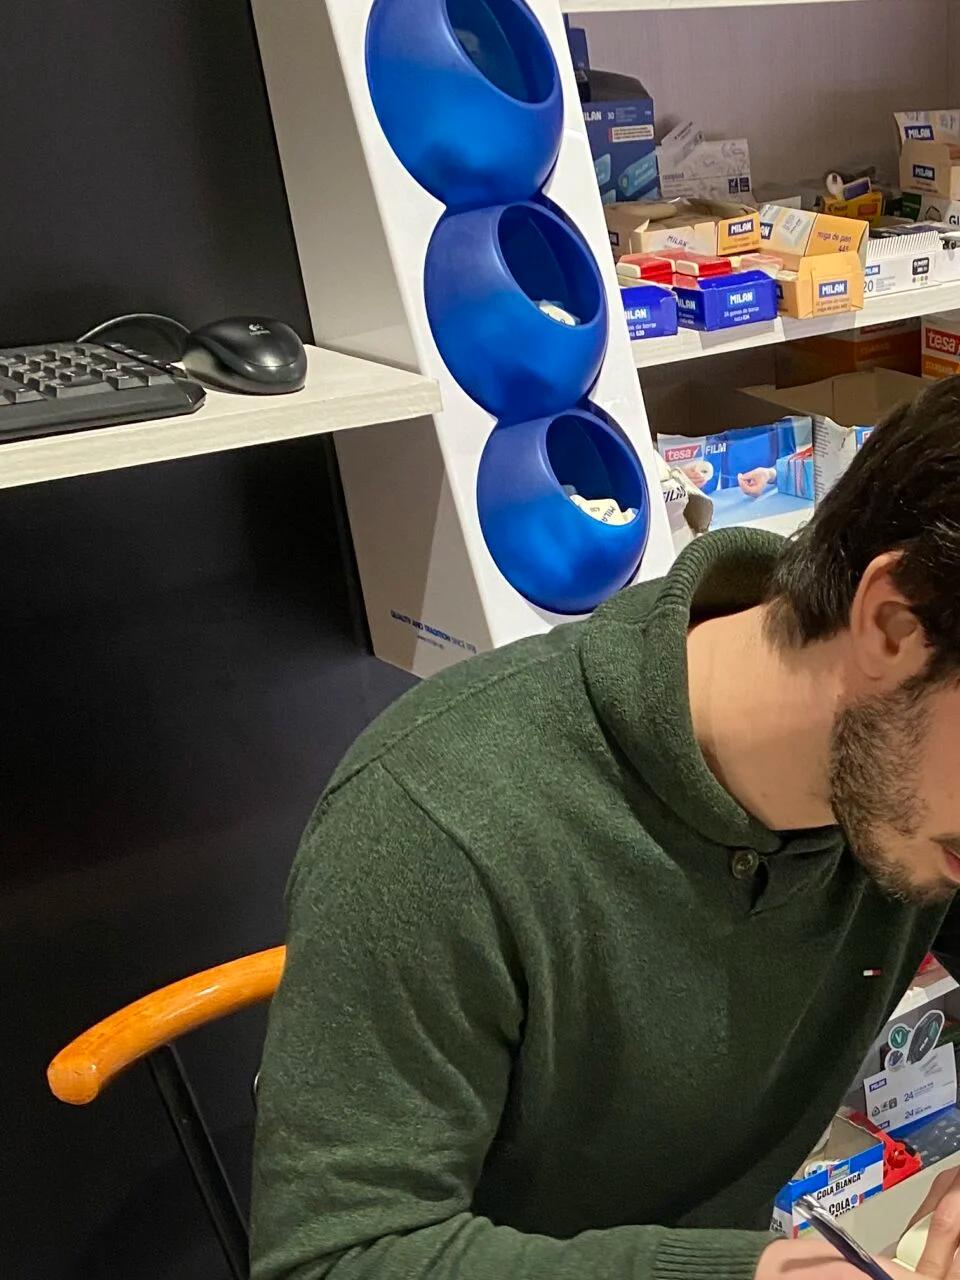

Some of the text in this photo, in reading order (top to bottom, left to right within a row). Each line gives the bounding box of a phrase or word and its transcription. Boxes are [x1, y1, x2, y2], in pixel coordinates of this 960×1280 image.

[908, 127, 931, 139] MILAN
[730, 220, 752, 234] MILAN
[821, 282, 845, 297] MILAN
[730, 291, 753, 305] MILAN
[927, 331, 956, 353] tesa
[667, 448, 692, 461] tesa
[705, 442, 727, 456] FILM
[904, 1092, 914, 1102] 24
[816, 1173, 861, 1200] COLA BLANCA
[828, 1197, 850, 1216] COLA
